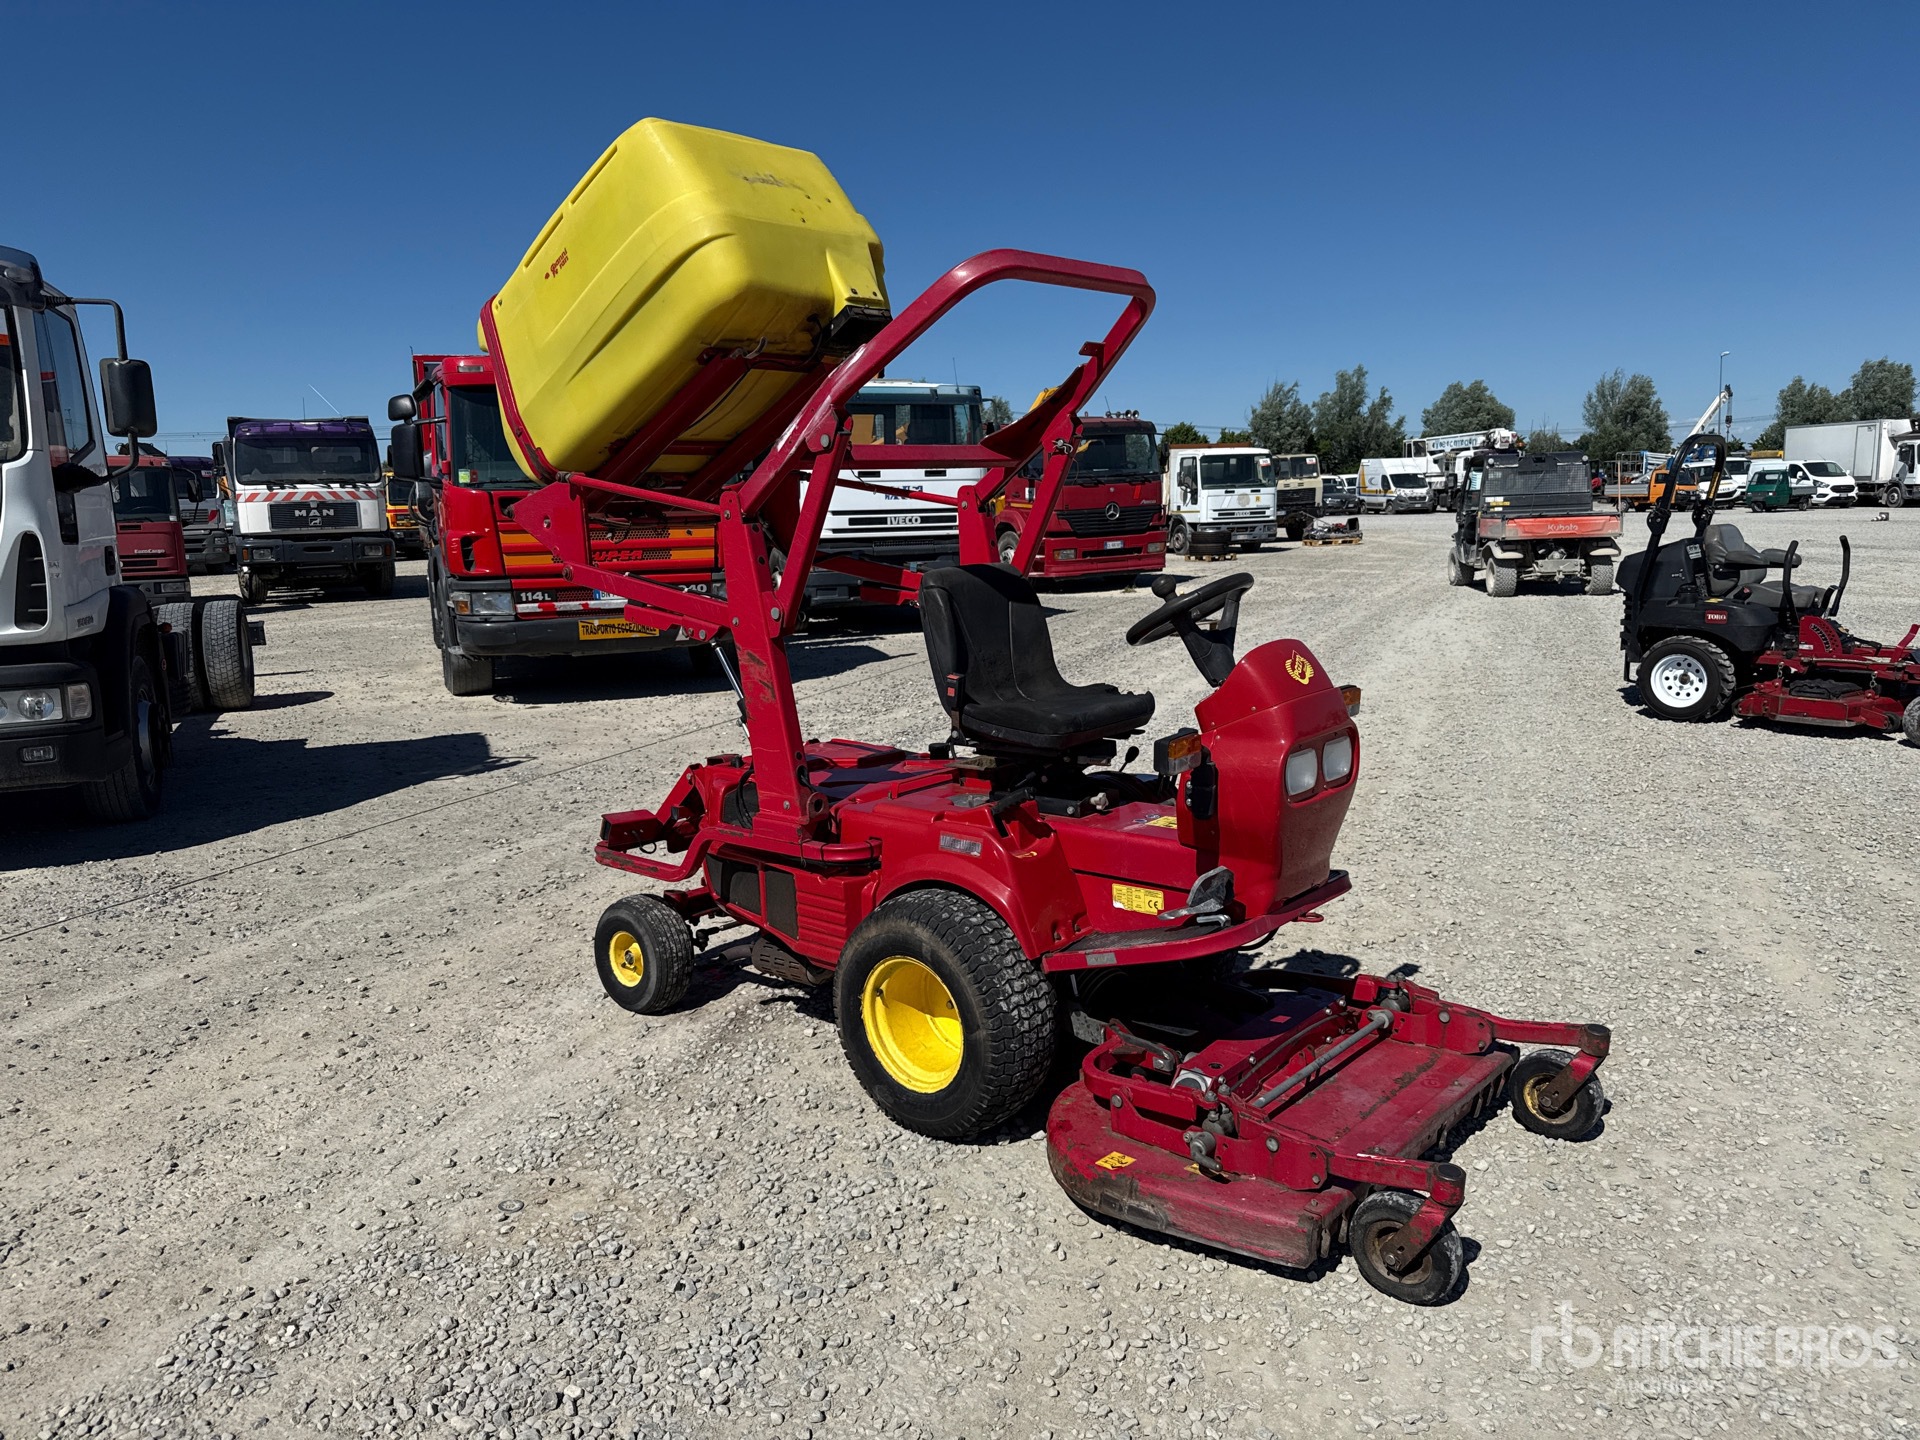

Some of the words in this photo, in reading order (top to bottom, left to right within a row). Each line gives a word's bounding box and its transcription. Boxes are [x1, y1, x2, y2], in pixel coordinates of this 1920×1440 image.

[294, 509, 335, 517] MAN
[886, 516, 921, 526] IVECO
[1547, 523, 1579, 532] Kubota
[592, 550, 643, 561] UPER
[581, 623, 616, 636] TRASPORTO
